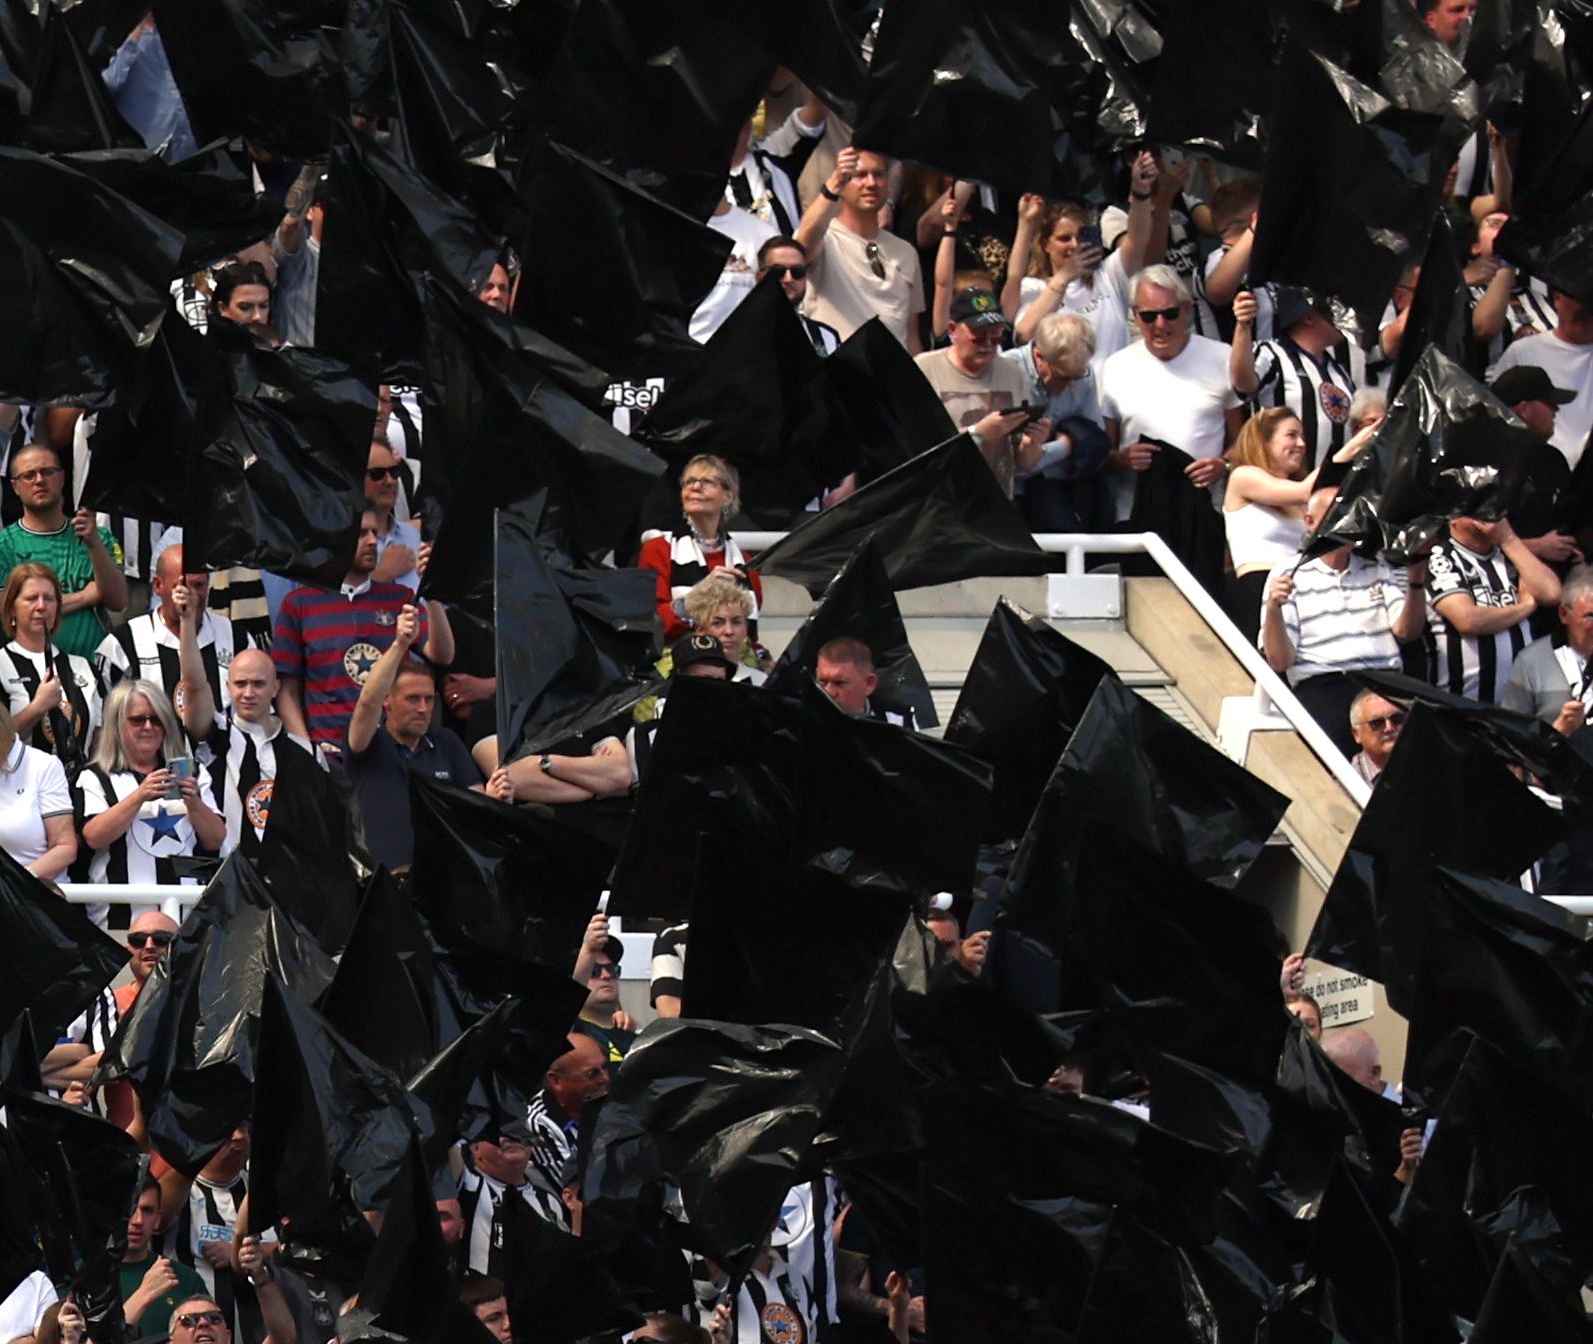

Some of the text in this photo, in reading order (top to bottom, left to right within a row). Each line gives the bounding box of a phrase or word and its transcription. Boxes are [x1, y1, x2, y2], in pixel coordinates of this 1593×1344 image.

[624, 386, 657, 407] sel
[1327, 981, 1339, 994] not
[1340, 976, 1368, 991] smoke
[1340, 999, 1358, 1013] area
